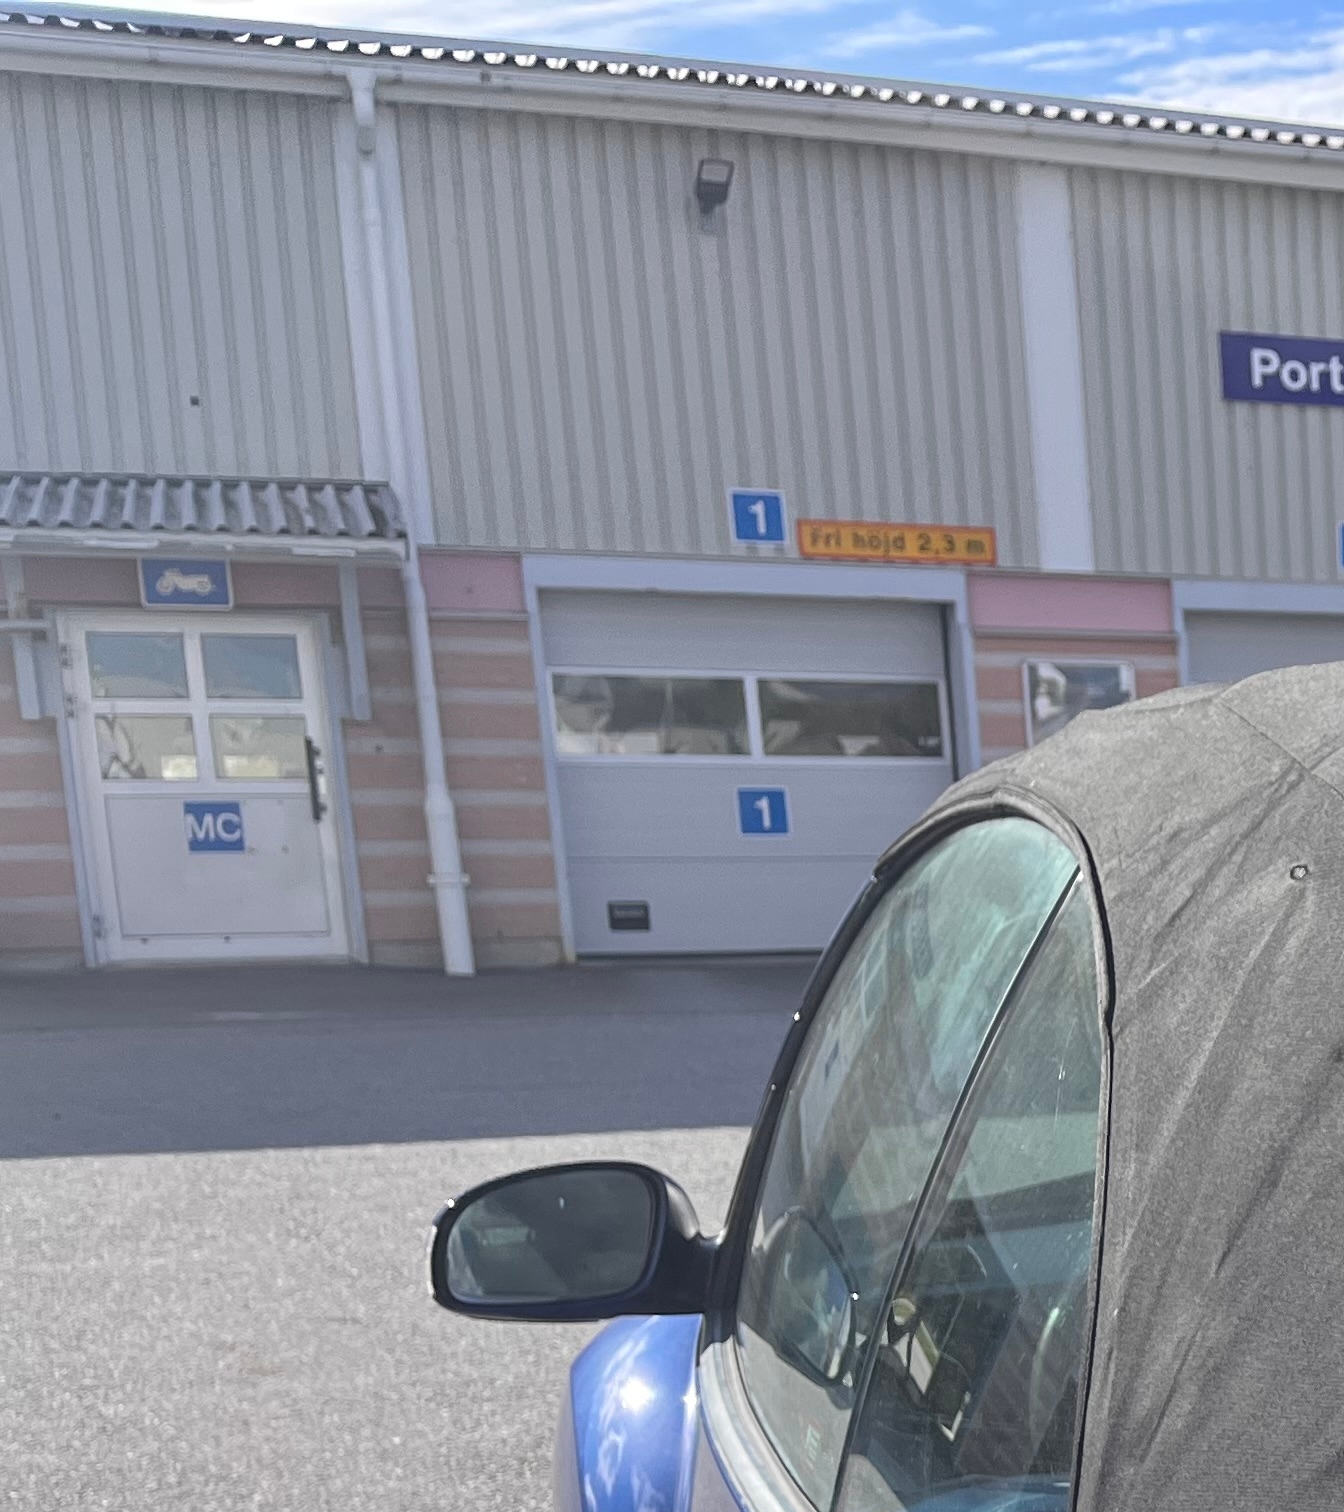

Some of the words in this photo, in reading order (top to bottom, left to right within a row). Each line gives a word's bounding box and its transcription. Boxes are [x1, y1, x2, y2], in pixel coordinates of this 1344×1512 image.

[747, 499, 768, 538] 1
[810, 526, 842, 549] Fri
[966, 538, 985, 554] m
[184, 811, 242, 842] MC
[753, 795, 773, 831] 1
